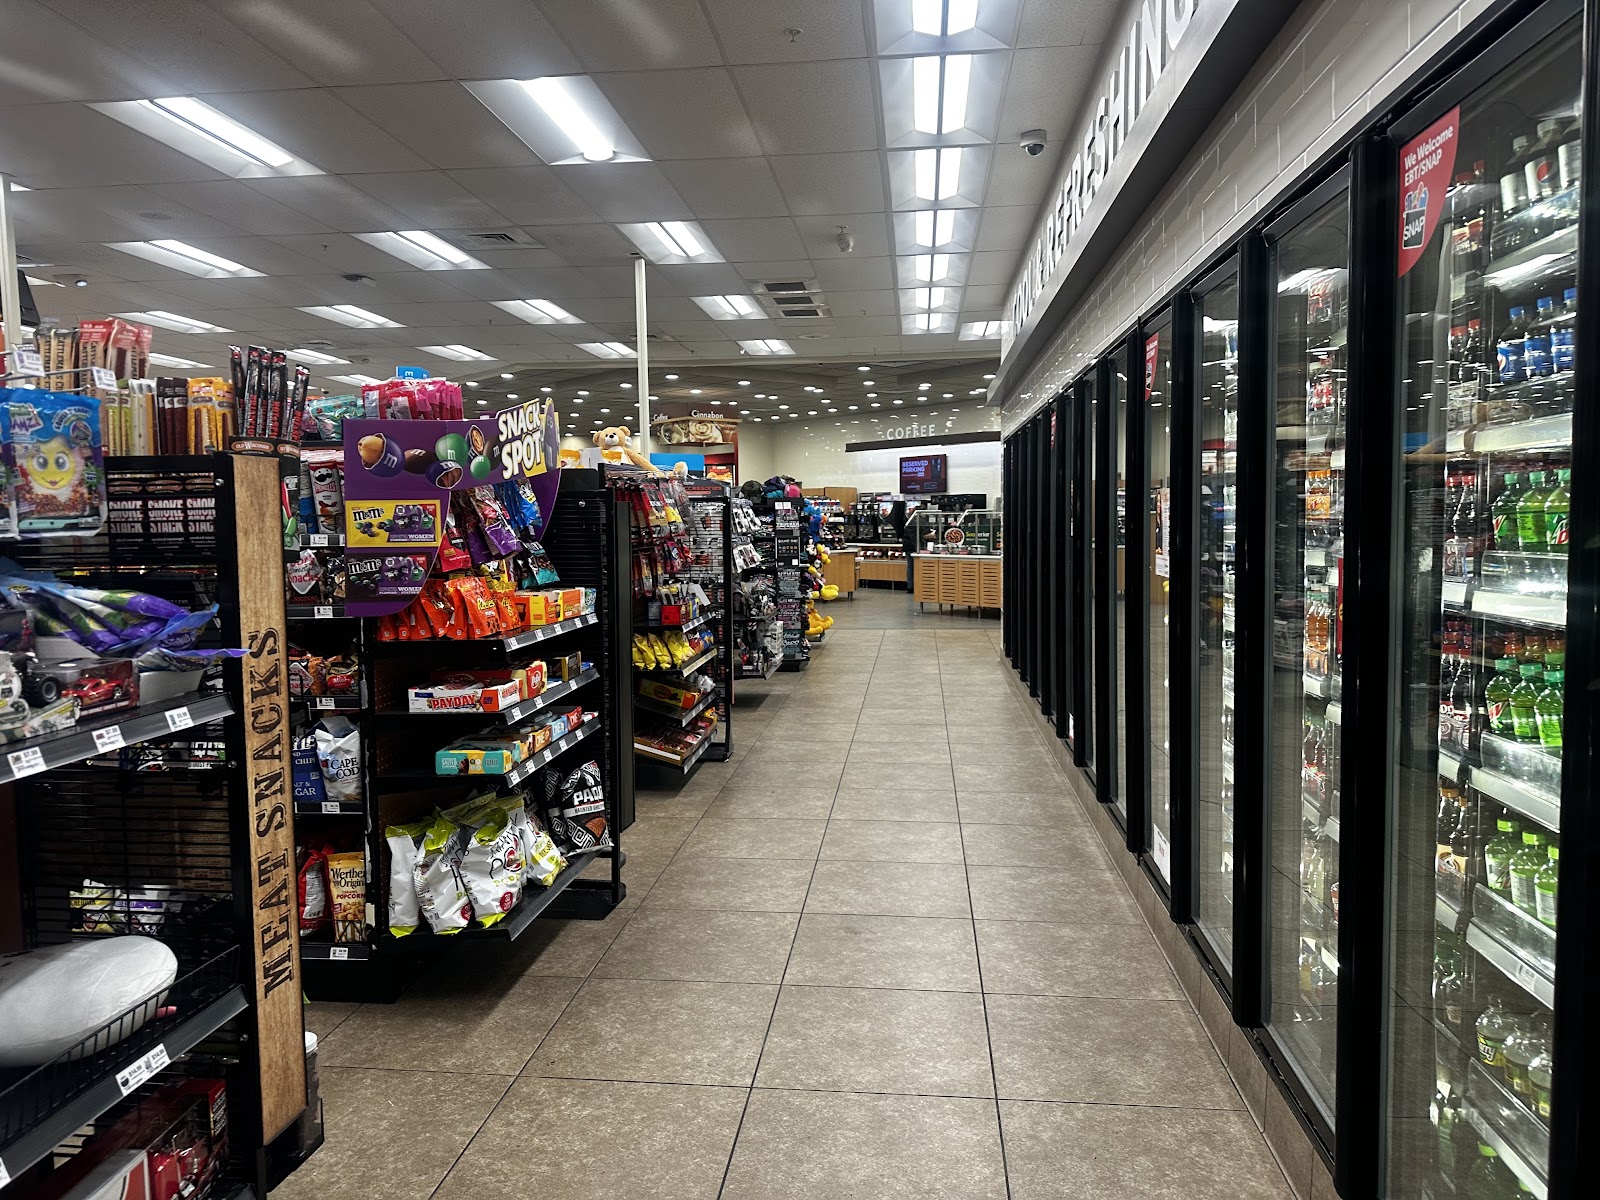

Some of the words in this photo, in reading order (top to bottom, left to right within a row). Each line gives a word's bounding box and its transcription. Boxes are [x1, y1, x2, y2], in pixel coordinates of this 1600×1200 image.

[1404, 151, 1417, 171] We
[1416, 125, 1454, 161] Welcome
[1404, 148, 1443, 188] EBT/SNAP
[1403, 215, 1426, 241] SNAP
[498, 402, 541, 443] SNACK
[653, 413, 669, 421] Coffee
[691, 409, 724, 419] Cinnabon
[886, 424, 936, 440] COFFEE
[501, 430, 542, 481] SPOT
[315, 482, 337, 493] PRINGLES
[109, 500, 144, 518] SMOKE
[148, 500, 184, 517] SMOKE
[186, 497, 217, 518] SMOK
[110, 517, 144, 534] STACK
[149, 517, 184, 533] STACK
[187, 516, 215, 533] STAC
[431, 693, 476, 711] PAYDAY
[248, 626, 288, 839] SNACKS
[331, 757, 359, 770] CAPE
[336, 766, 360, 780] COD
[294, 787, 316, 796] GAR
[339, 878, 365, 889] Origin
[336, 892, 366, 900] POPCORN
[257, 847, 296, 1000] MEAT
